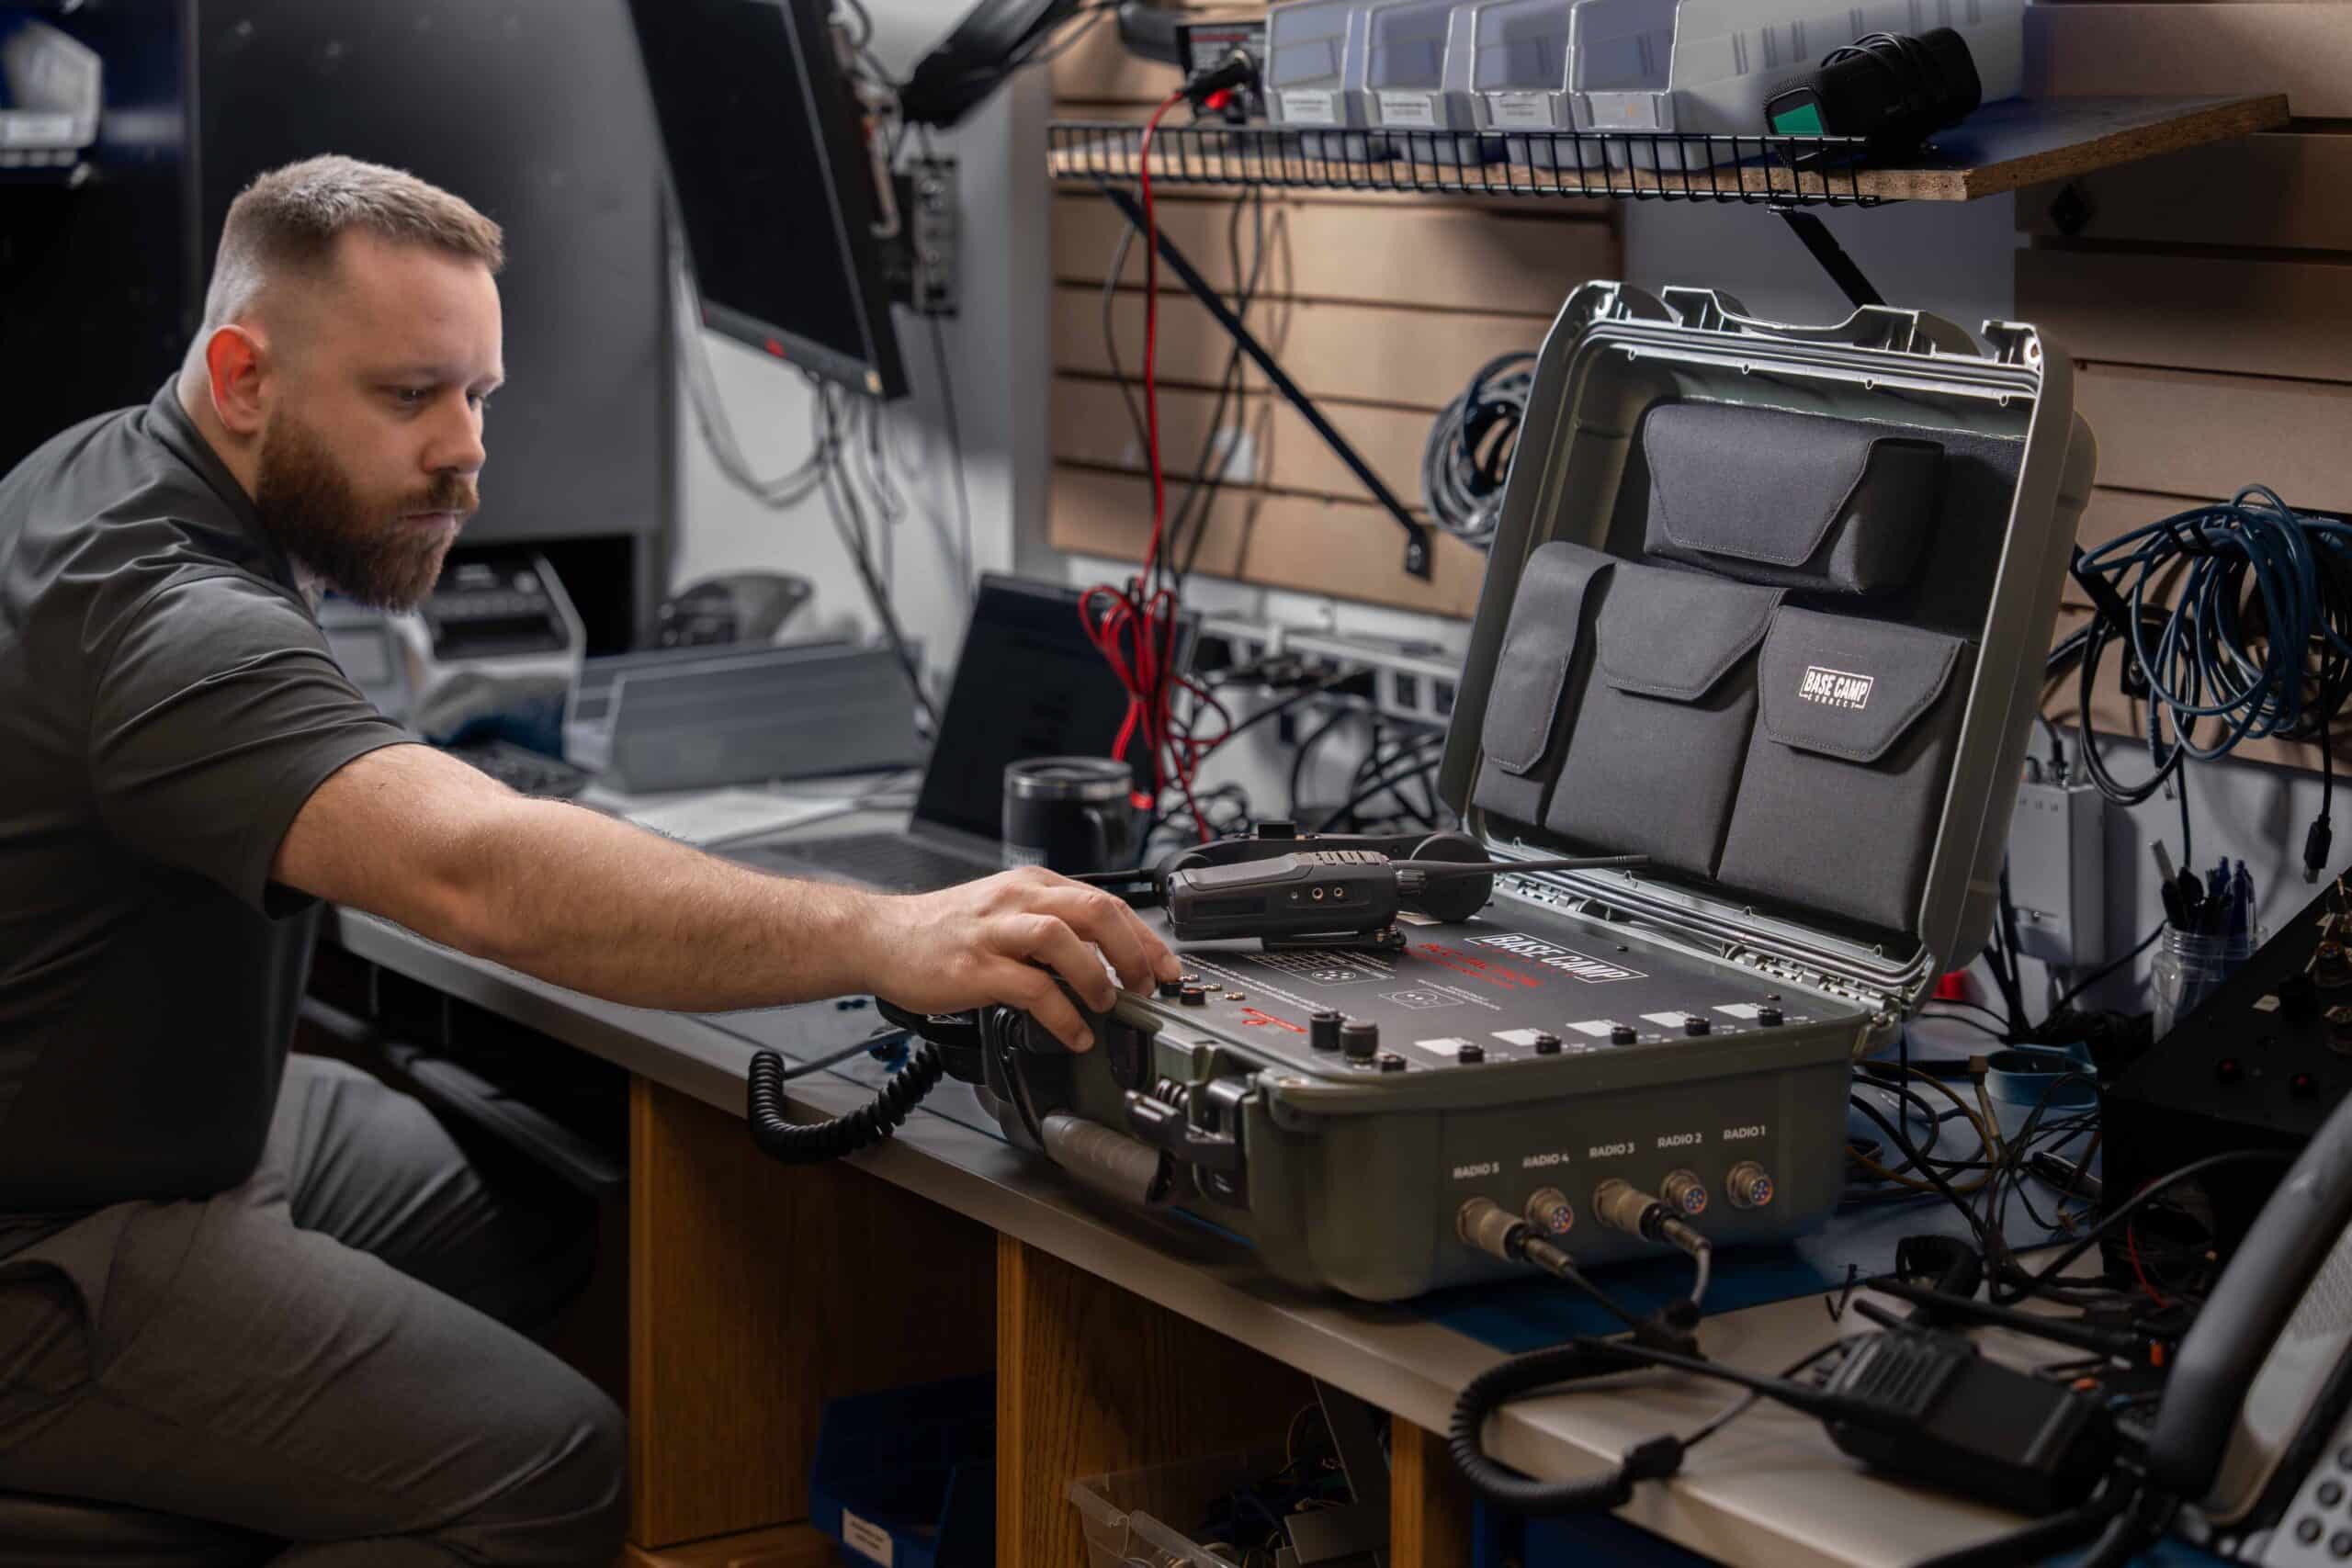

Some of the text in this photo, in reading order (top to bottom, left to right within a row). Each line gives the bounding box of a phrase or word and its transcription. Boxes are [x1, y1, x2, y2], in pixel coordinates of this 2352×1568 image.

[1804, 671, 1869, 702] BASE CAMP
[1479, 934, 1566, 958] BASE
[1539, 955, 1631, 980] CAMP
[1657, 1133, 1702, 1147] RADIO 2
[1724, 1125, 1766, 1140] RADIO 1
[1589, 1142, 1635, 1158] RADIO 3
[1522, 1153, 1570, 1168] RADIO 4
[1453, 1164, 1489, 1179] RADIO
